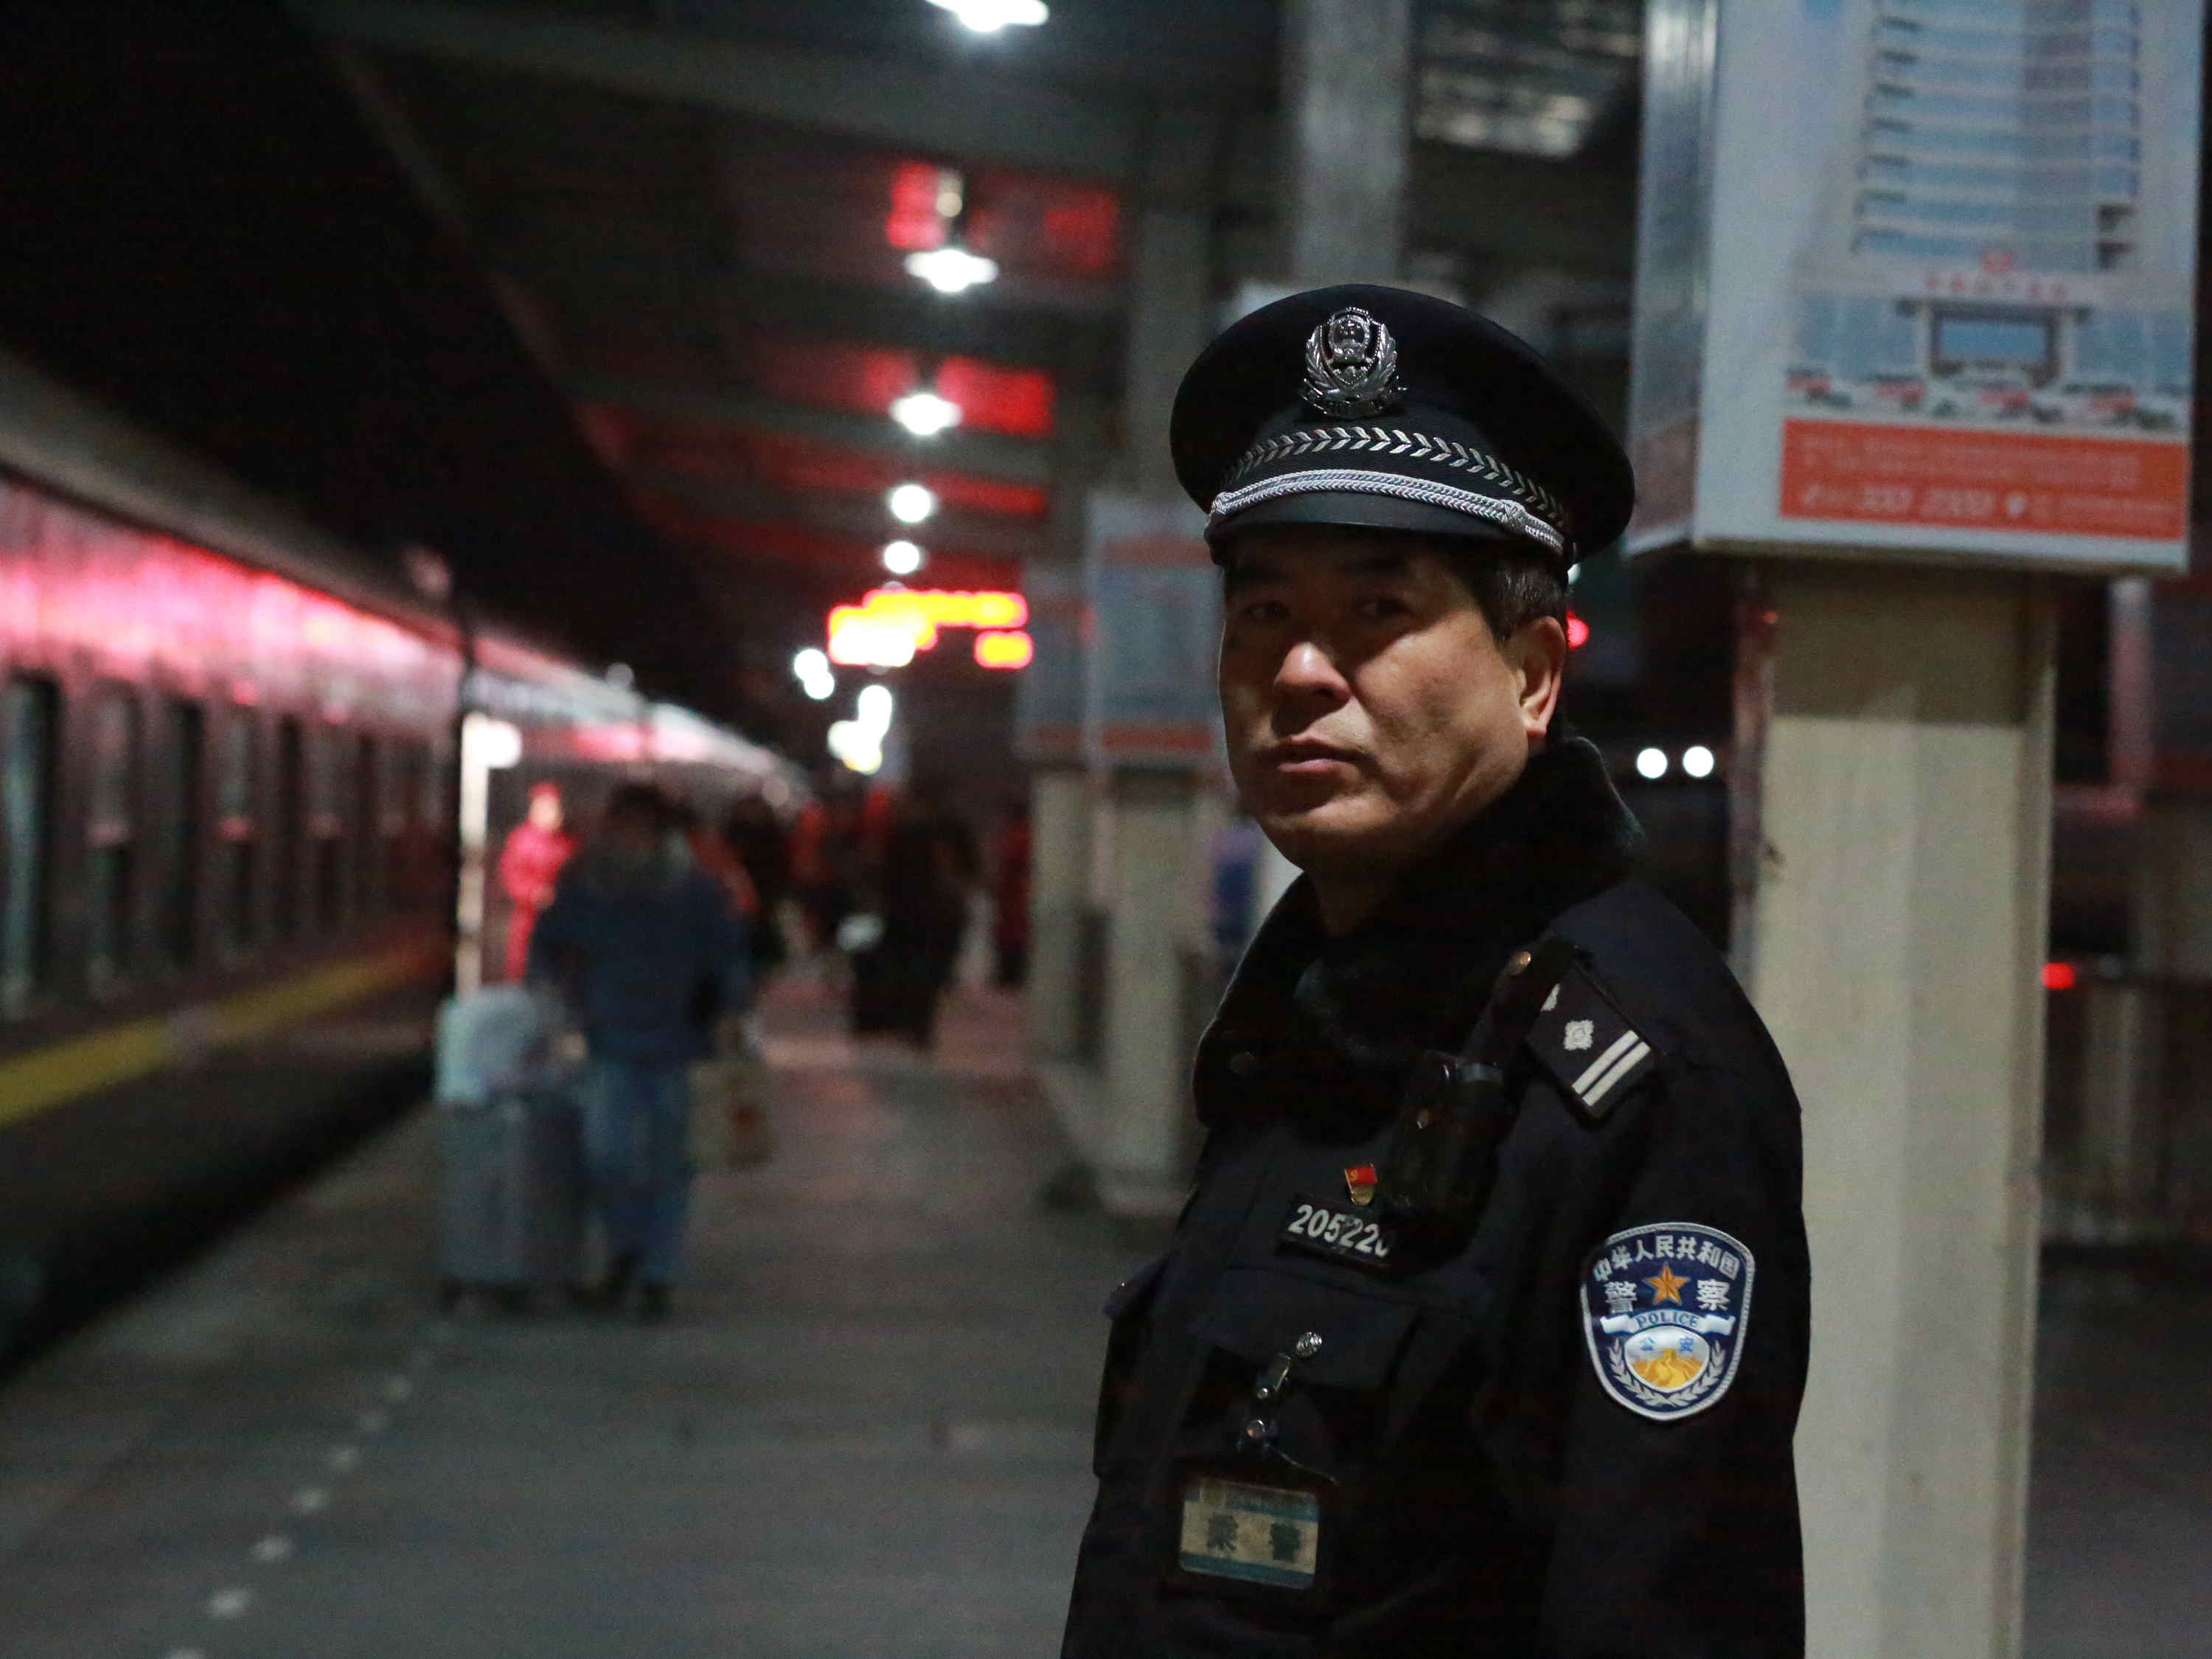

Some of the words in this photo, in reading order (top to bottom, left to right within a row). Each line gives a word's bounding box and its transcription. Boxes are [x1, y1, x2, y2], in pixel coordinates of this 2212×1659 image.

[1593, 1234, 1741, 1281] 中华人民共和国
[1604, 1279, 1731, 1314] 警察
[1634, 1310, 1700, 1329] POLICE
